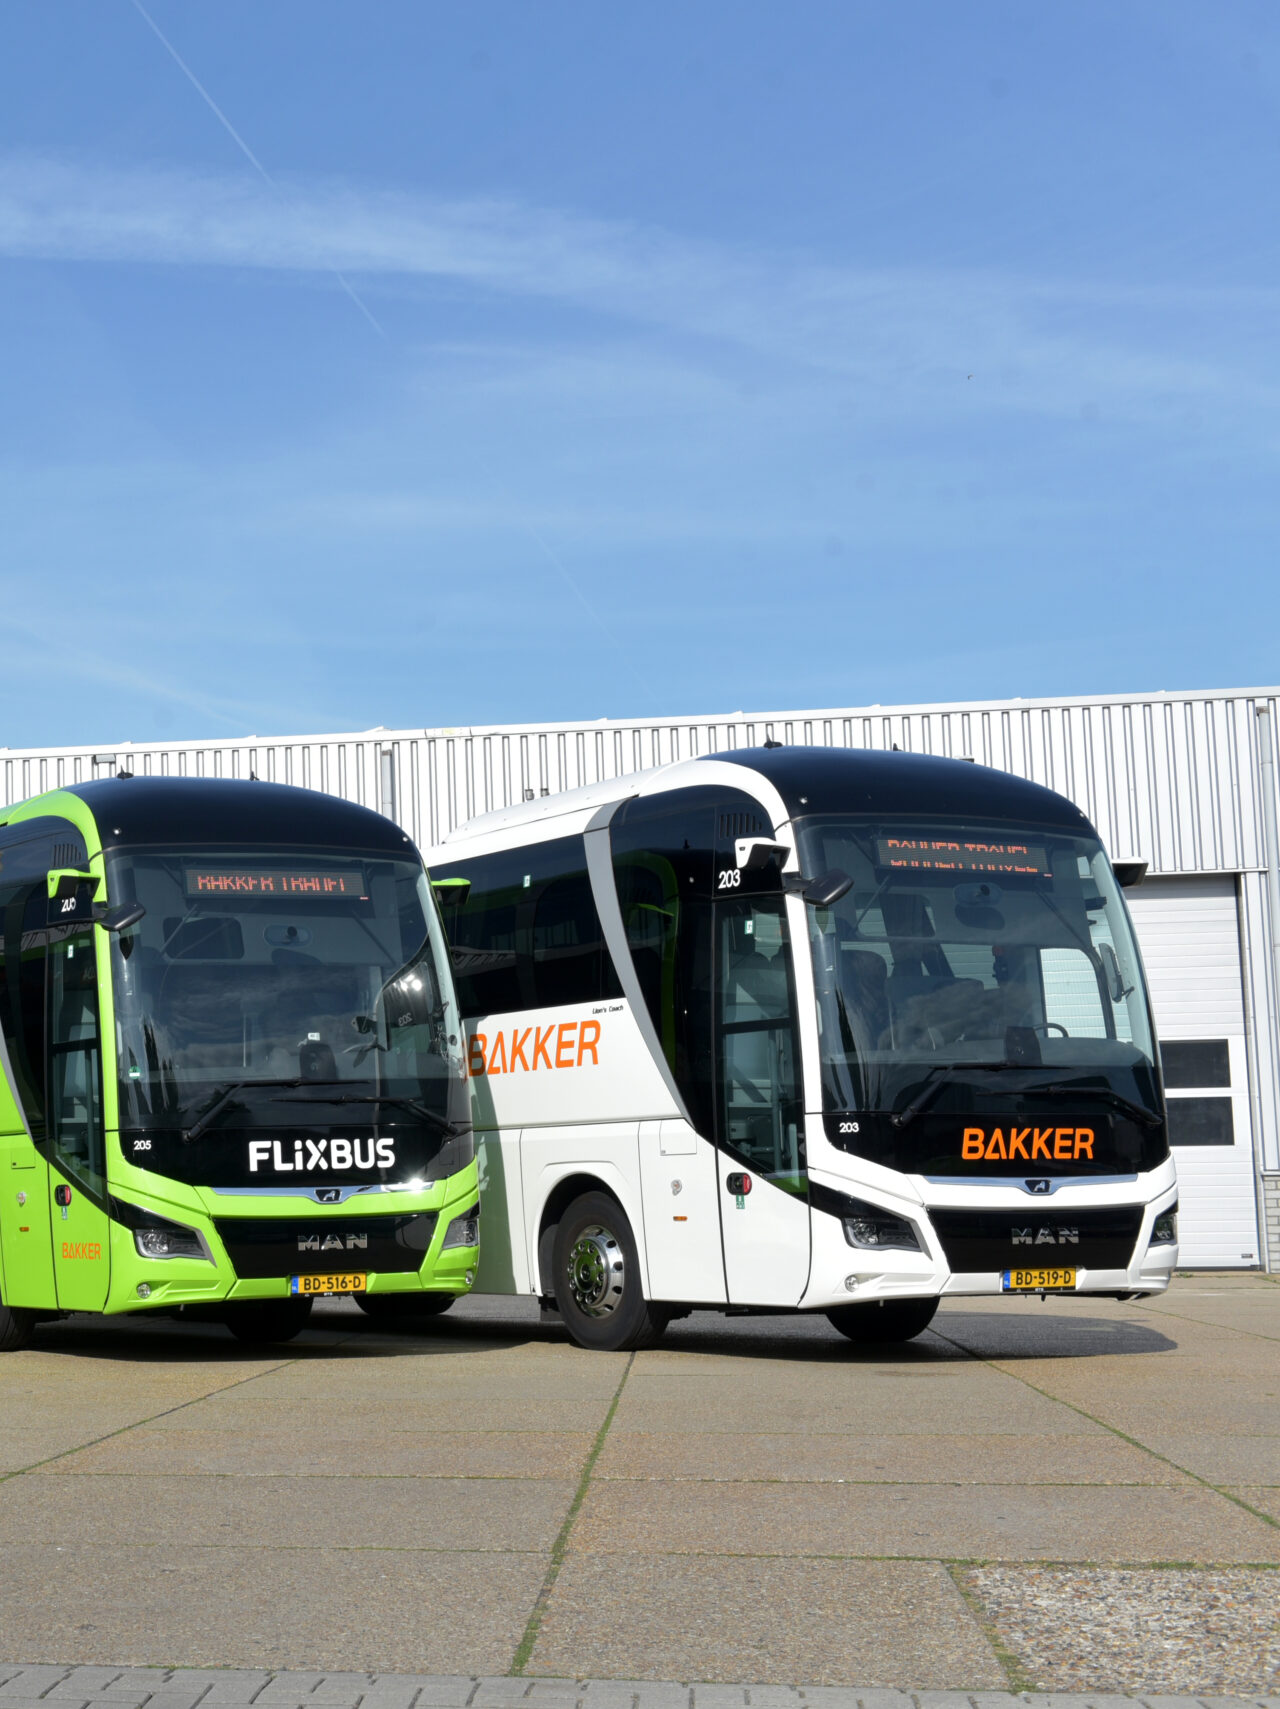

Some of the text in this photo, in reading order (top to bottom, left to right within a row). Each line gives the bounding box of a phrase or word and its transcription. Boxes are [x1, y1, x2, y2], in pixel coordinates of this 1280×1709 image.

[718, 868, 741, 889] 203
[468, 1019, 601, 1077] BAKKER
[839, 1122, 859, 1134] 203
[133, 1140, 152, 1151] 205
[961, 1127, 1095, 1160] BAKKER
[297, 1232, 368, 1251] MAN
[1011, 1227, 1080, 1245] MAN
[62, 1241, 102, 1260] BAKKER
[303, 1275, 362, 1291] BD-516-D
[1015, 1270, 1072, 1286] BD-519-D
